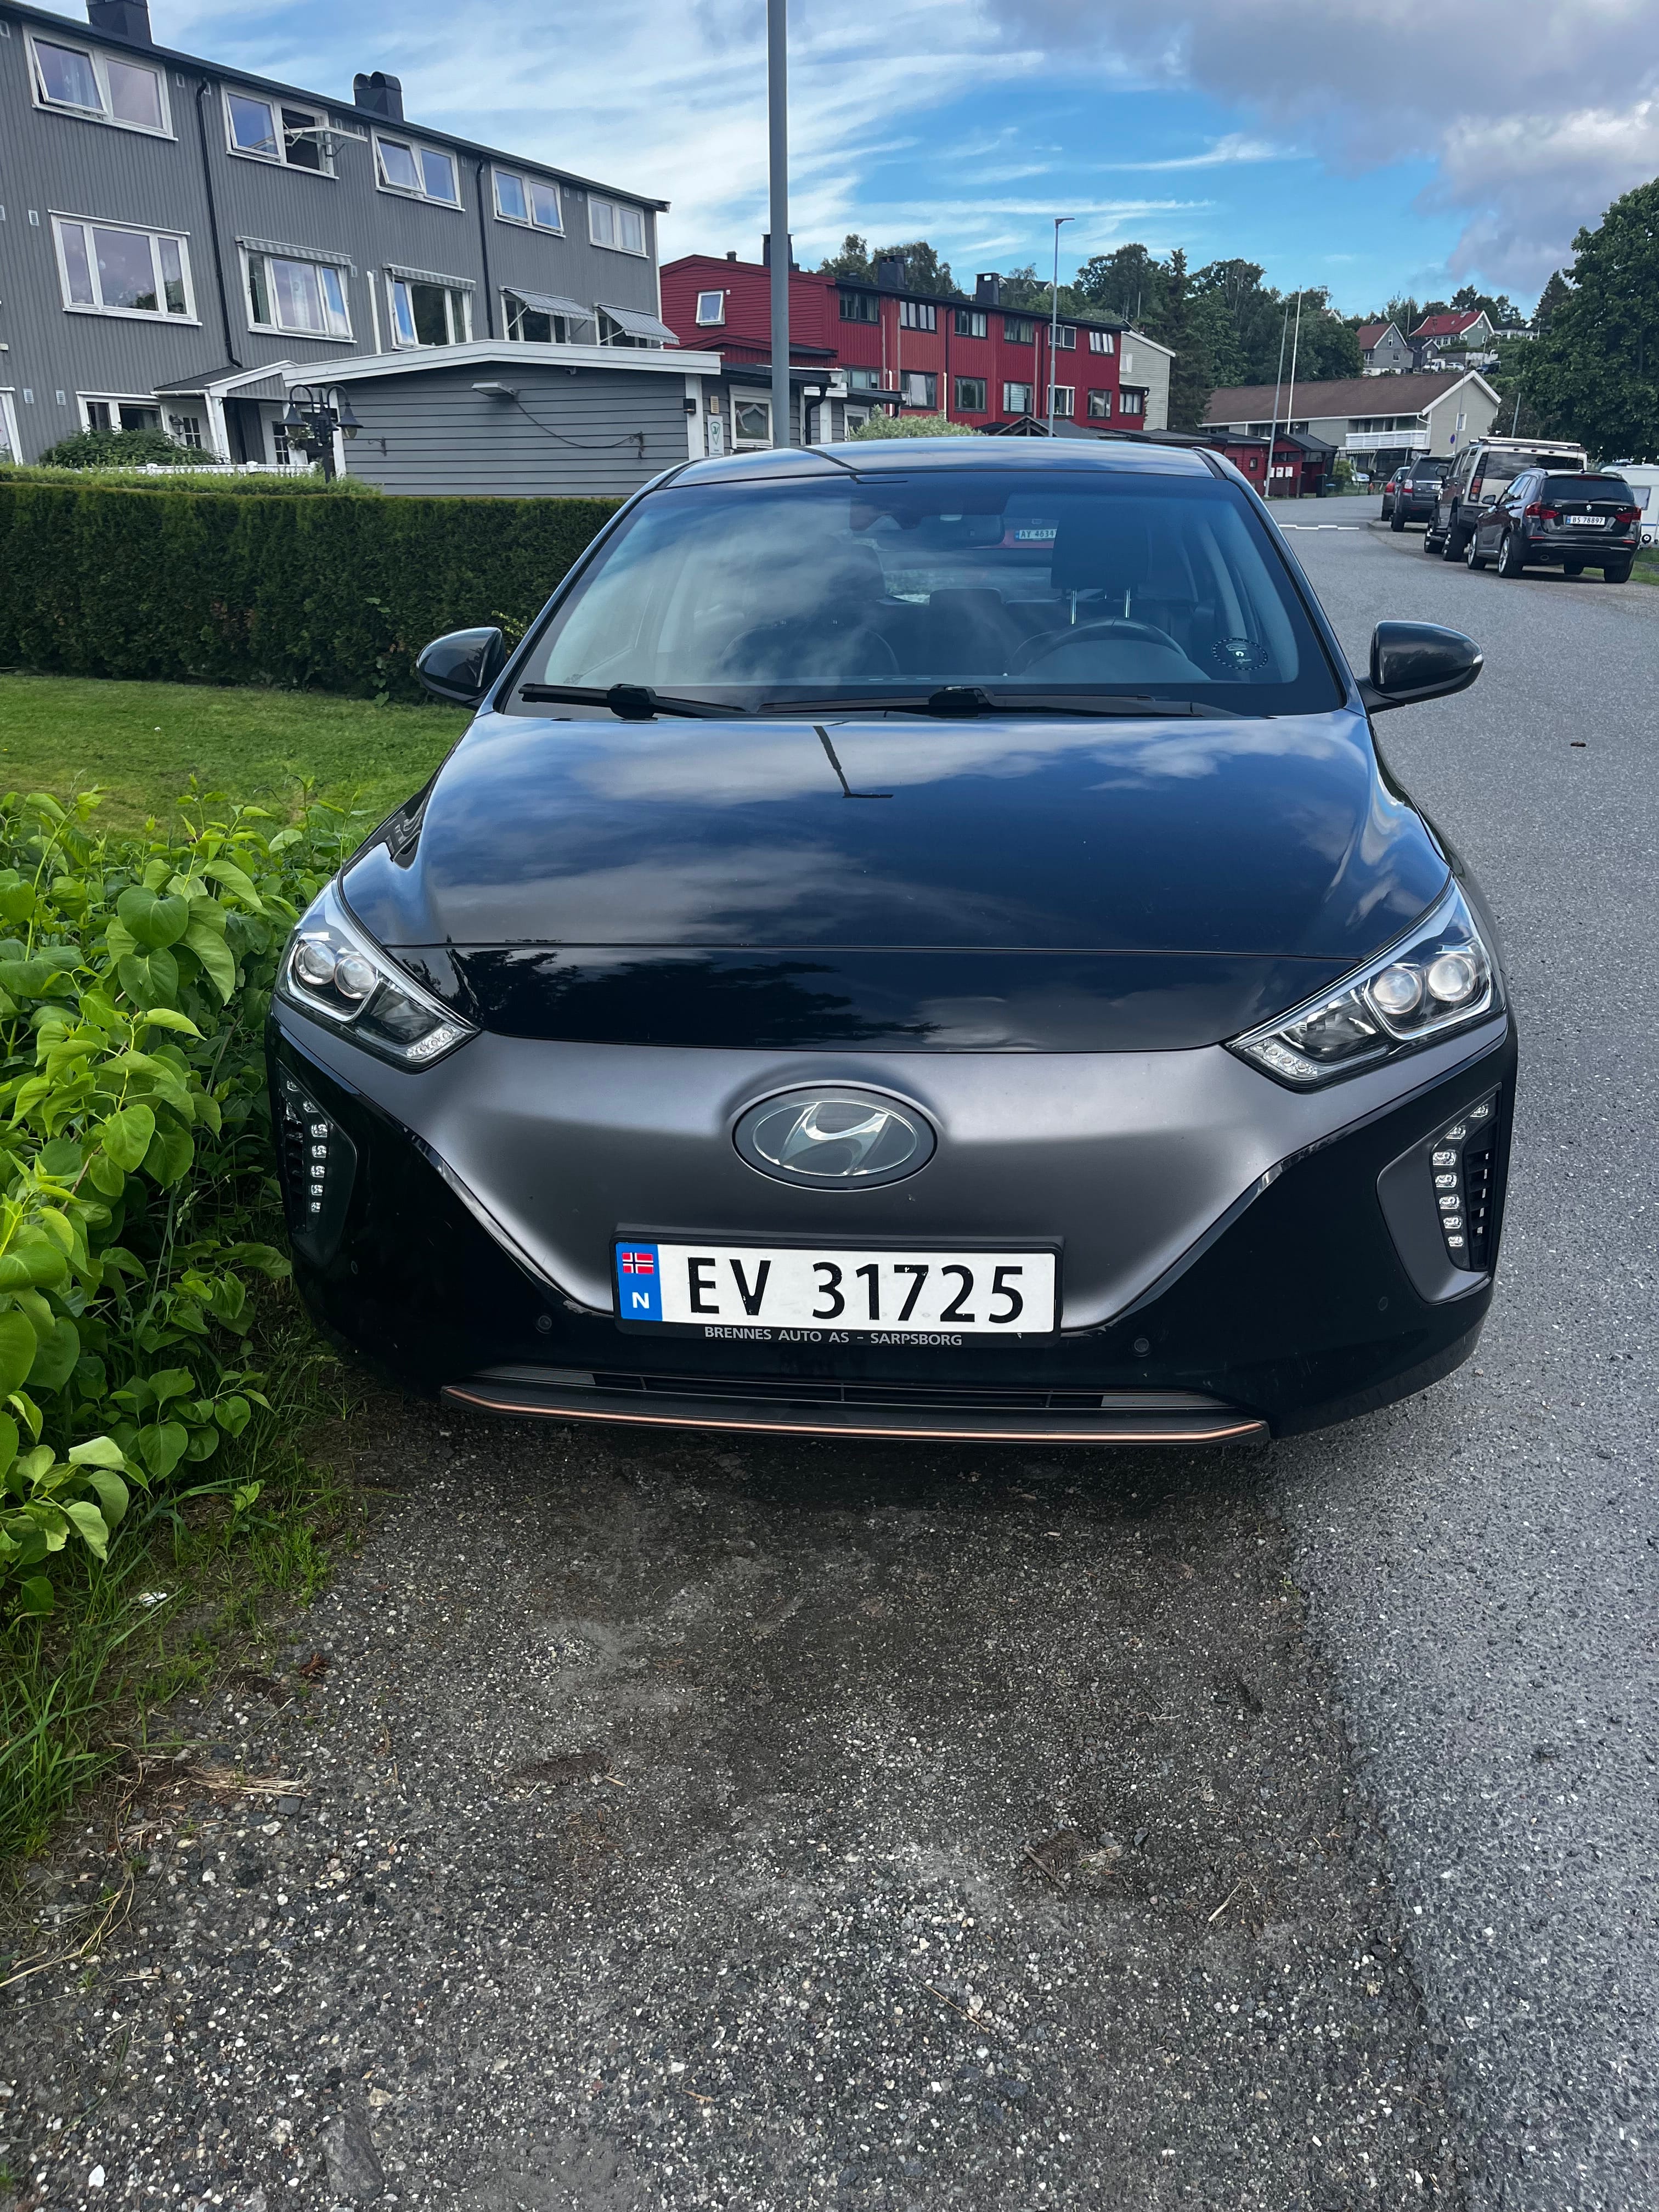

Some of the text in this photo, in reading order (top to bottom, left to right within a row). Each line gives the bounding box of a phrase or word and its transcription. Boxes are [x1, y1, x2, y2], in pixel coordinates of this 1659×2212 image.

[1020, 529, 1057, 538] AY 4634
[687, 1256, 1023, 1324] EV 31725
[631, 1291, 650, 1309] N
[704, 1326, 772, 1340] BRENNES
[778, 1329, 822, 1343] AUTO
[828, 1331, 849, 1344] AS
[870, 1333, 962, 1346] SARPSBORG
